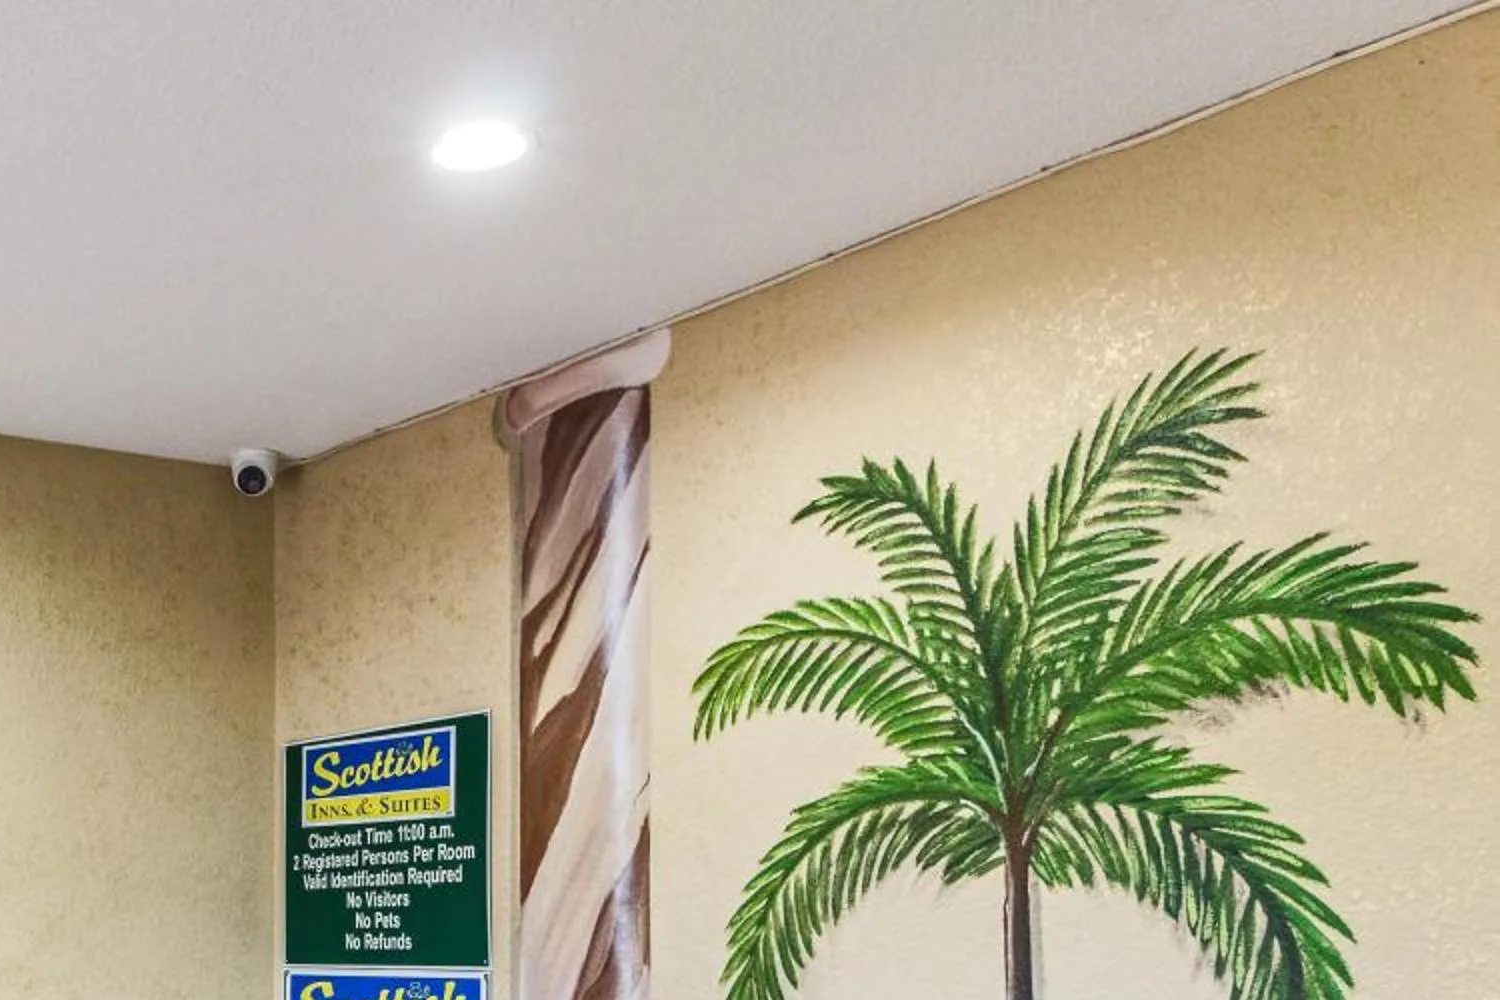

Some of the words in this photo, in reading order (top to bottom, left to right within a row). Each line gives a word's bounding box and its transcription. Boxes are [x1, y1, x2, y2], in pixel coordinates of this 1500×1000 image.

[311, 735, 443, 797] Scottish
[356, 798, 373, 816] &
[379, 795, 442, 815] SUITES
[308, 829, 362, 849] Check-out
[365, 827, 393, 845] Time
[398, 823, 425, 841] 11:00
[429, 824, 455, 840] a.m.
[293, 855, 300, 871] 2
[302, 850, 359, 872] Registered
[361, 849, 409, 866] Persons
[413, 845, 434, 862] Per
[437, 844, 475, 860] Room
[303, 873, 328, 890] Valid
[331, 869, 404, 889] Identification
[407, 865, 463, 888] Required
[346, 891, 362, 908] No
[365, 891, 410, 908] Visitors
[355, 912, 371, 929] No
[375, 911, 401, 929] Pets
[345, 933, 361, 950] No
[364, 932, 413, 950] Refunds
